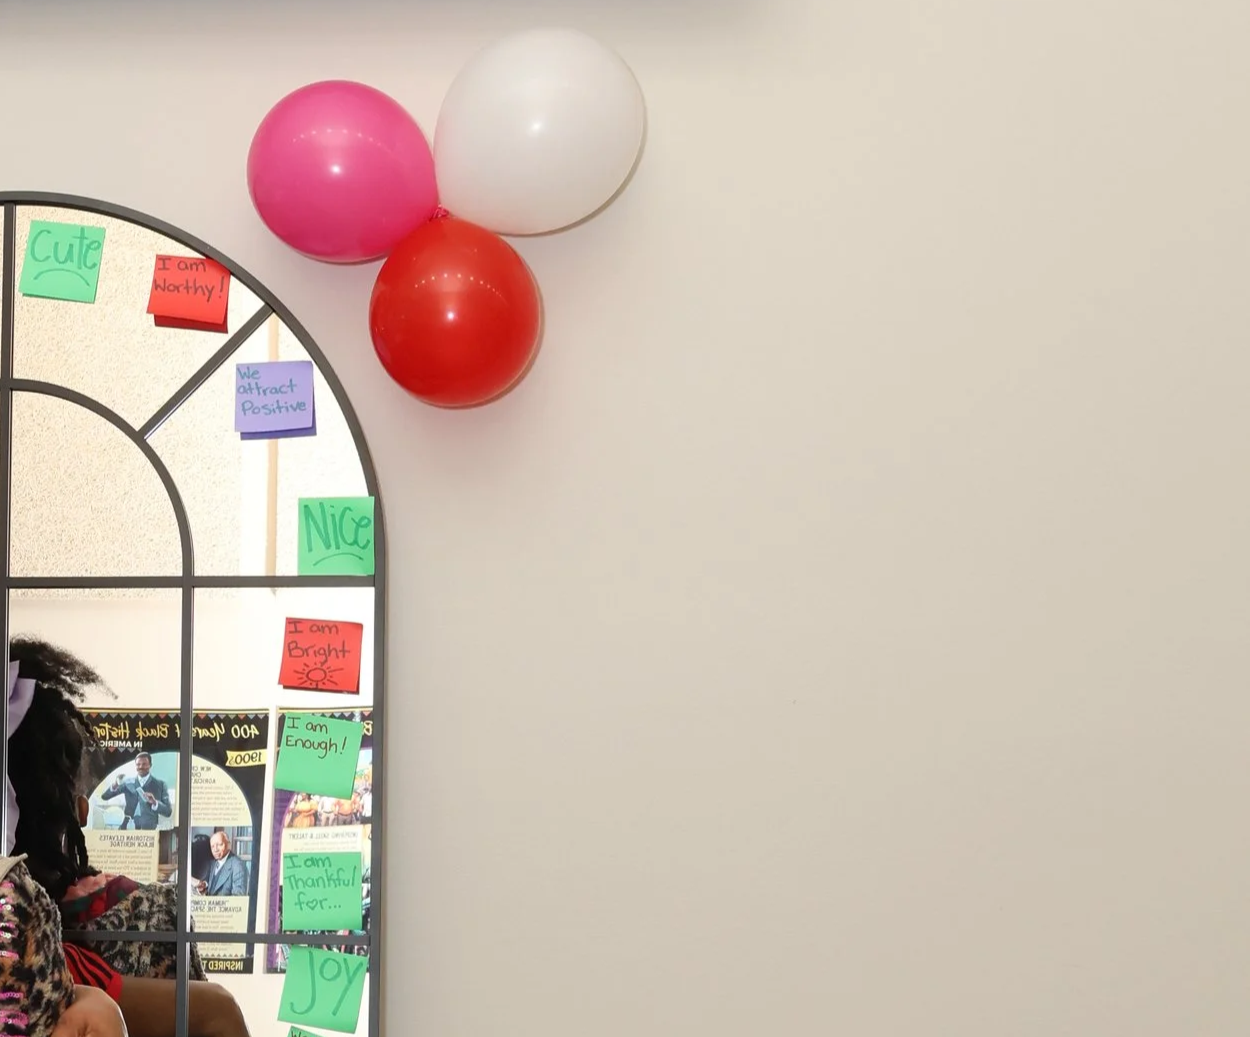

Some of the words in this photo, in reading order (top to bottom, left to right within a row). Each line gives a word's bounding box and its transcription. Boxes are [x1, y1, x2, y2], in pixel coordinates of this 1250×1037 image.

[30, 226, 102, 271] Cute
[157, 257, 172, 271] I
[176, 260, 206, 273] am
[153, 275, 225, 303] Worthy!
[237, 367, 261, 381] We
[237, 378, 297, 396] attract
[241, 399, 307, 416] Positive
[288, 620, 303, 634] I
[309, 623, 339, 635] am
[287, 640, 350, 667] Bright
[287, 716, 301, 729] I
[305, 721, 328, 734] am
[285, 735, 348, 760] Enough!
[284, 855, 301, 870] I
[303, 856, 332, 868] am
[284, 865, 357, 891] Thankful
